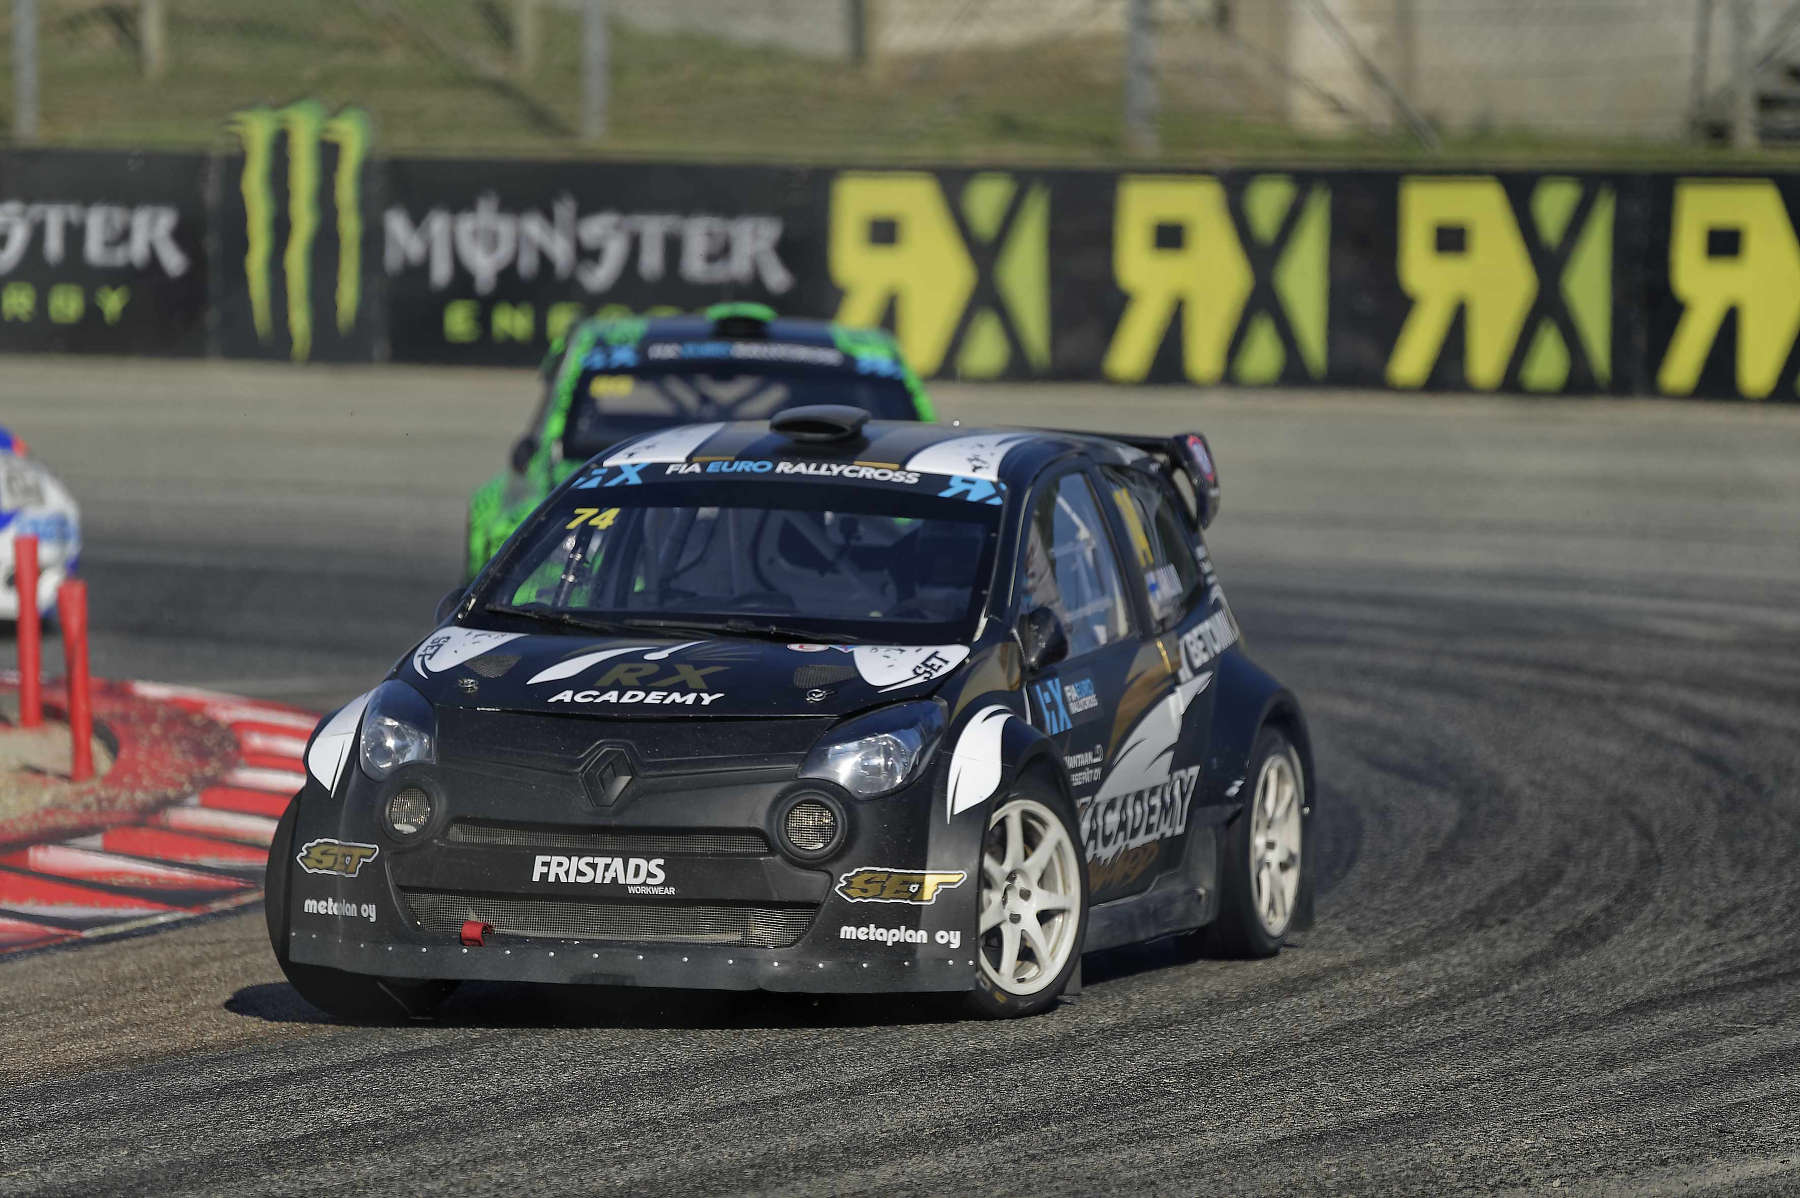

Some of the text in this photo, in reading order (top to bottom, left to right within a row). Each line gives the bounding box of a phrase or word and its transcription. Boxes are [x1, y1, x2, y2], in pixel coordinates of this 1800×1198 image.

[384, 192, 793, 294] MONSTER
[1657, 178, 1800, 399] R
[665, 460, 921, 484] FIA EURO RALLYCROSS
[565, 507, 621, 530] 74
[593, 663, 731, 690] RX
[911, 651, 950, 681] SET
[547, 689, 725, 706] ACADEMY
[532, 855, 666, 885] FRISTADS
[628, 886, 675, 895] WORKWEAR
[361, 904, 376, 922] oy
[840, 924, 961, 949] metaplan oy
